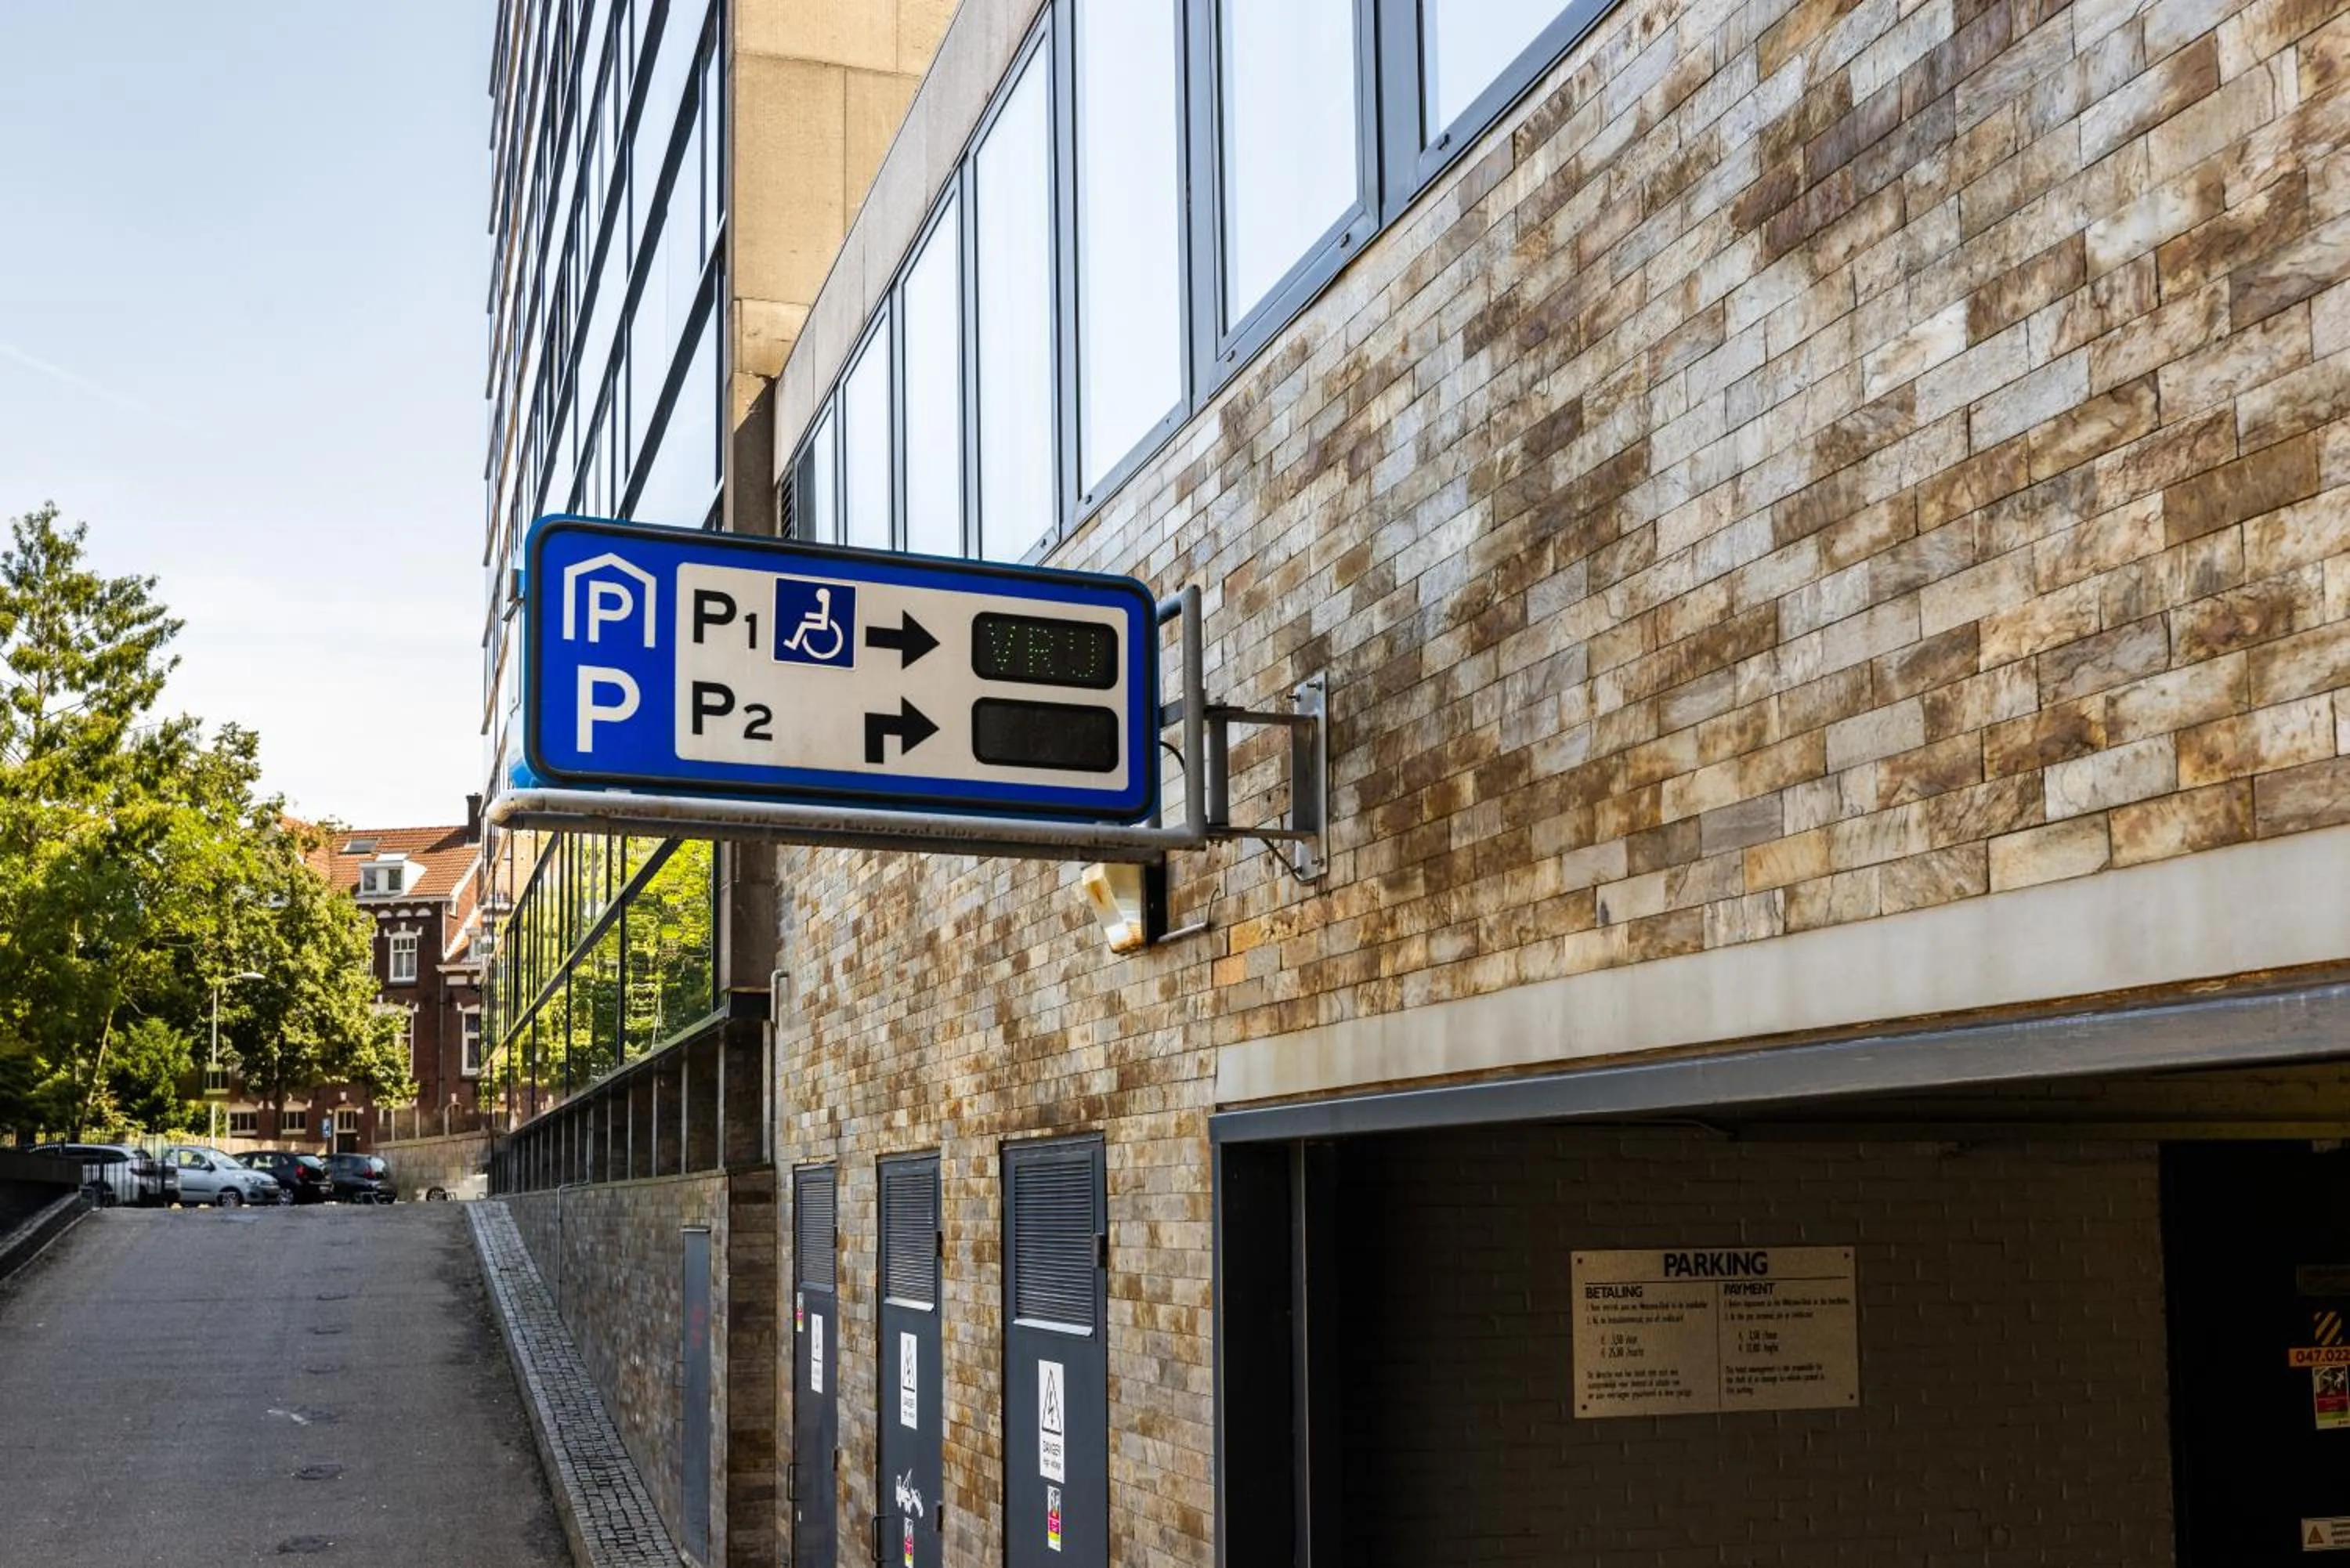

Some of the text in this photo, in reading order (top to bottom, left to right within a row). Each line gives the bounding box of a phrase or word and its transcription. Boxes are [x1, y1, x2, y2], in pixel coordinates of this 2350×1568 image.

[589, 582, 633, 642] P
[693, 588, 757, 650] P1
[577, 665, 641, 753] P
[692, 681, 773, 741] P2
[1585, 1286, 1643, 1299] BETALING
[1663, 1252, 1769, 1277] PARKING
[1723, 1283, 1776, 1295] PAYMENT
